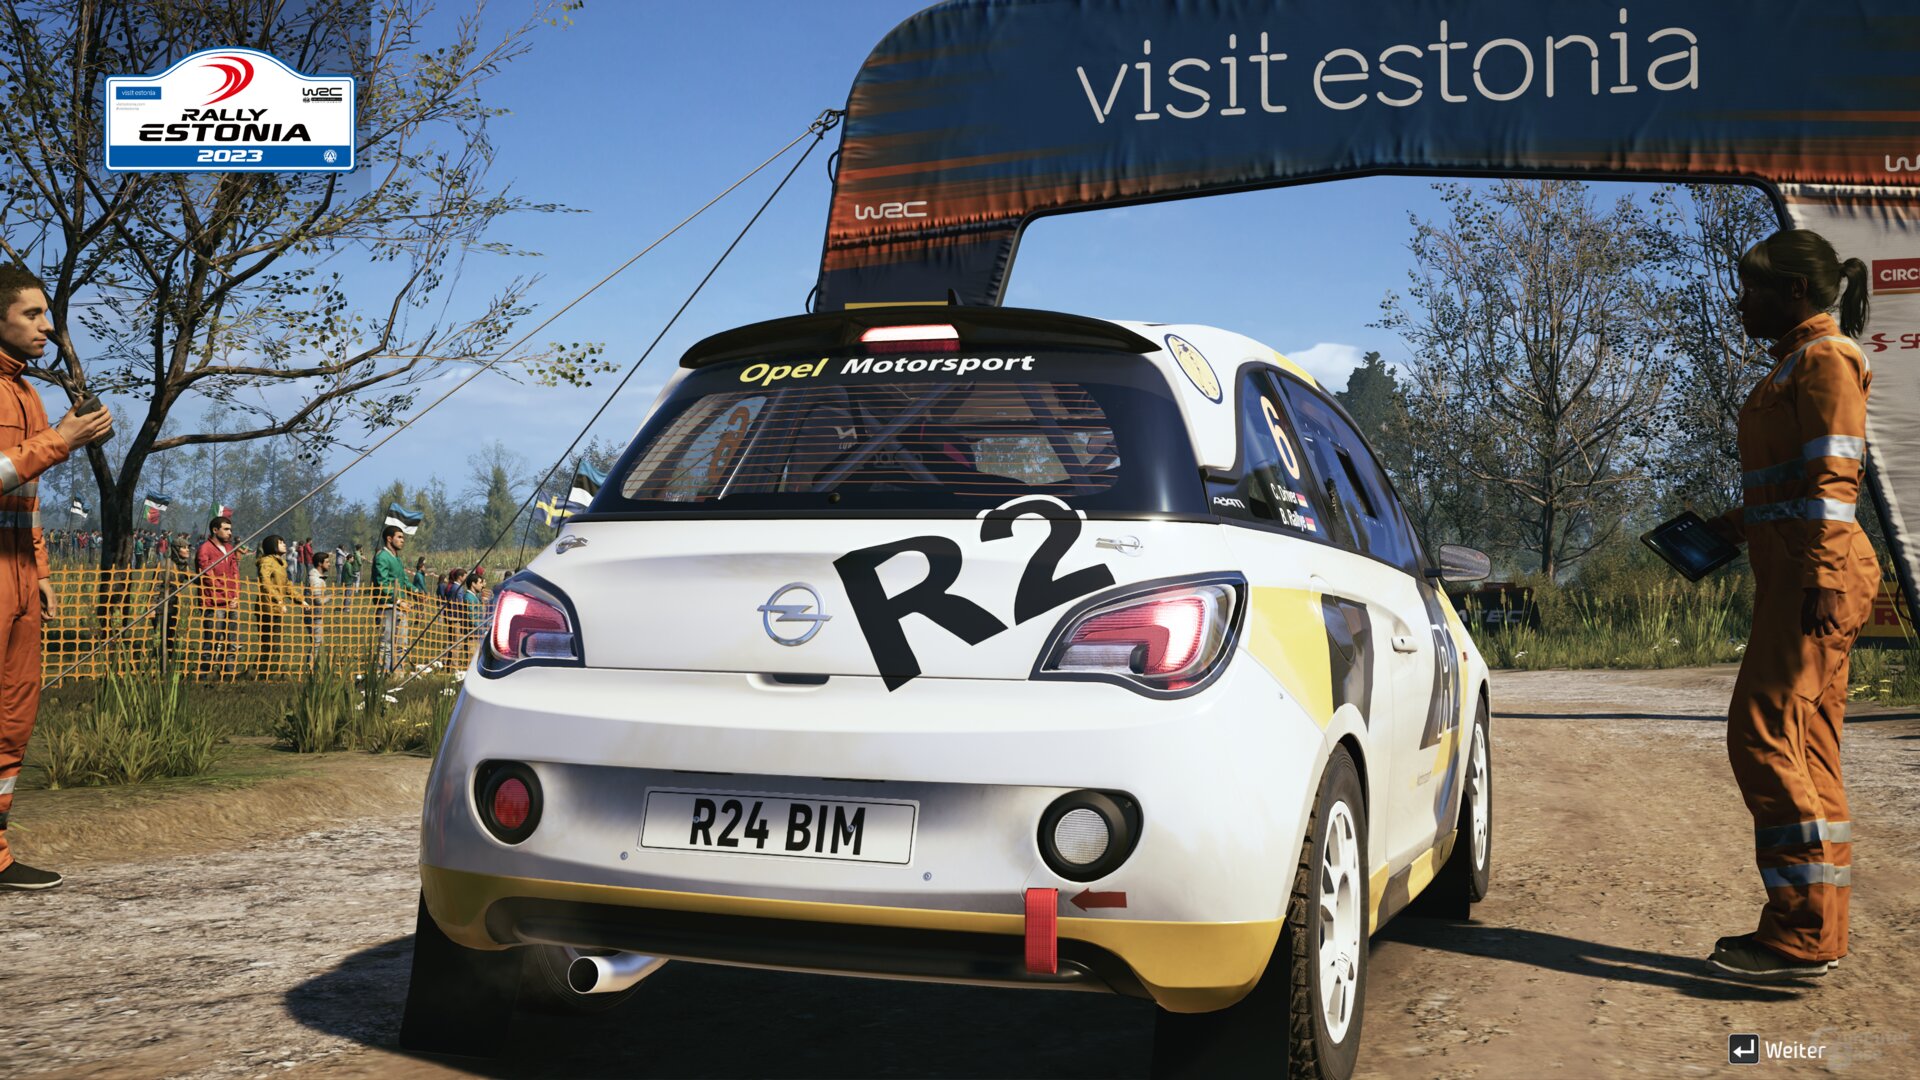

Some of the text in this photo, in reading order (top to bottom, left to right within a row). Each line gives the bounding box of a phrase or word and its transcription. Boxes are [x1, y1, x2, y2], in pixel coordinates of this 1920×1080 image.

[1077, 8, 1699, 123] visit estonia
[855, 201, 928, 220] WRC
[1880, 267, 1920, 281] CIRC
[739, 356, 1035, 386] Opel Motorsport
[1260, 395, 1300, 480] 6
[833, 494, 1116, 693] R2
[689, 798, 866, 856] R24 BIM
